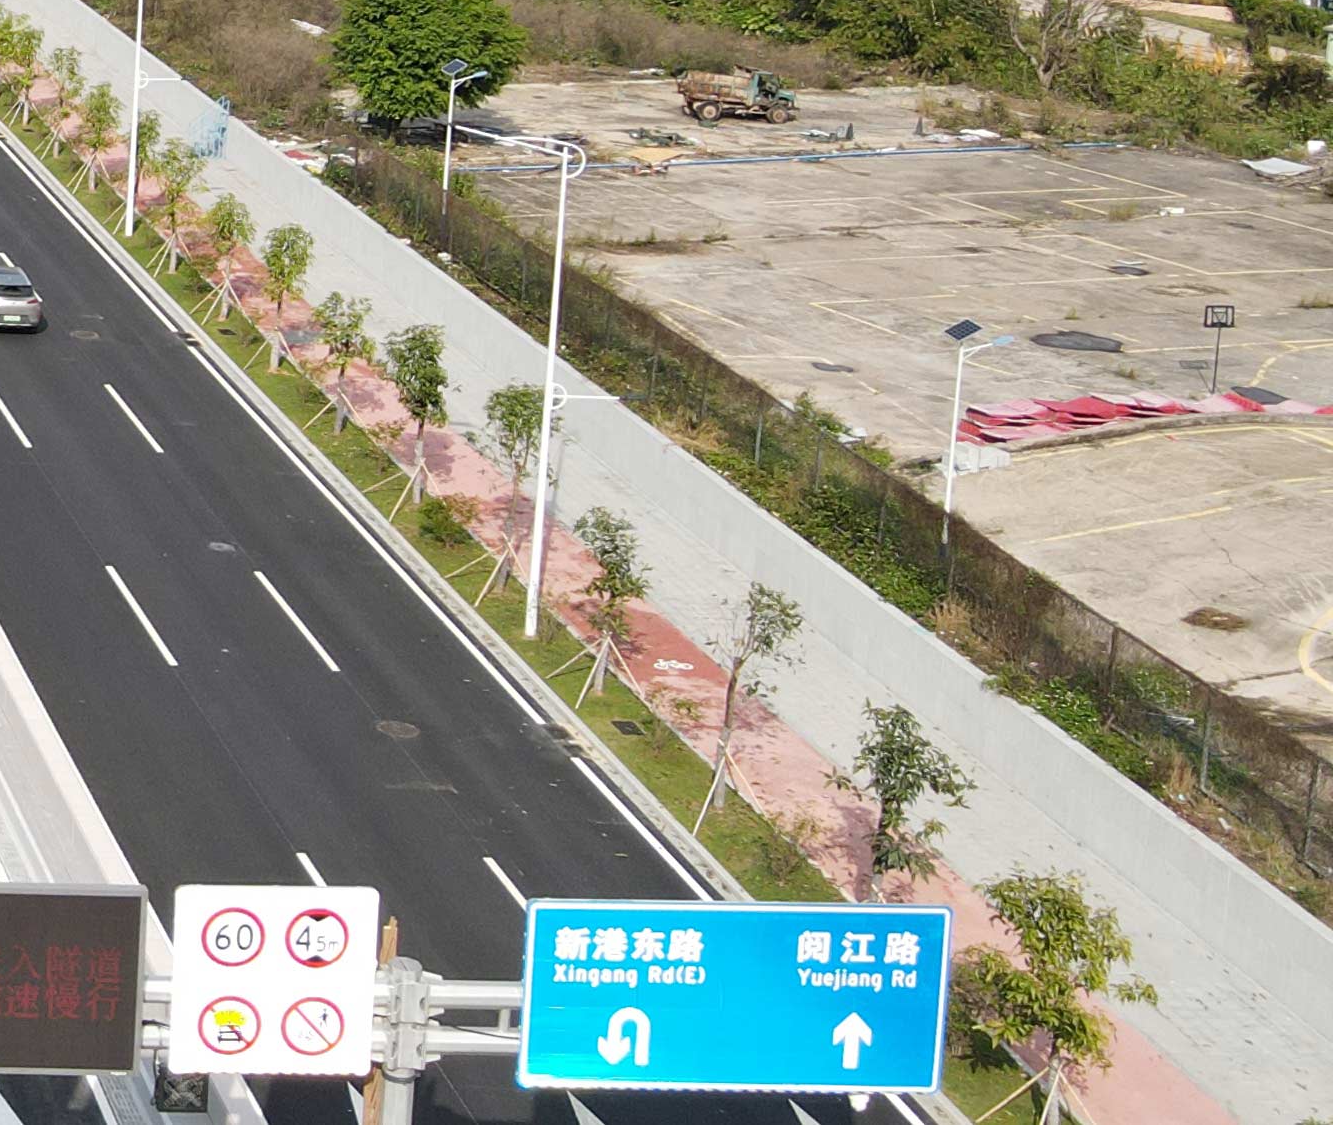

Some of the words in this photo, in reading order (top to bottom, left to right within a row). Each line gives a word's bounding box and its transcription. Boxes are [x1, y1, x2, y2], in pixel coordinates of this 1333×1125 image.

[215, 923, 254, 951] 60
[553, 926, 705, 963] 新港东路
[796, 930, 921, 966] 阅江路
[553, 963, 639, 988] Xingang
[648, 965, 706, 985] Rd(E)
[796, 967, 883, 992] Yuejiang
[891, 969, 916, 988] Rd
